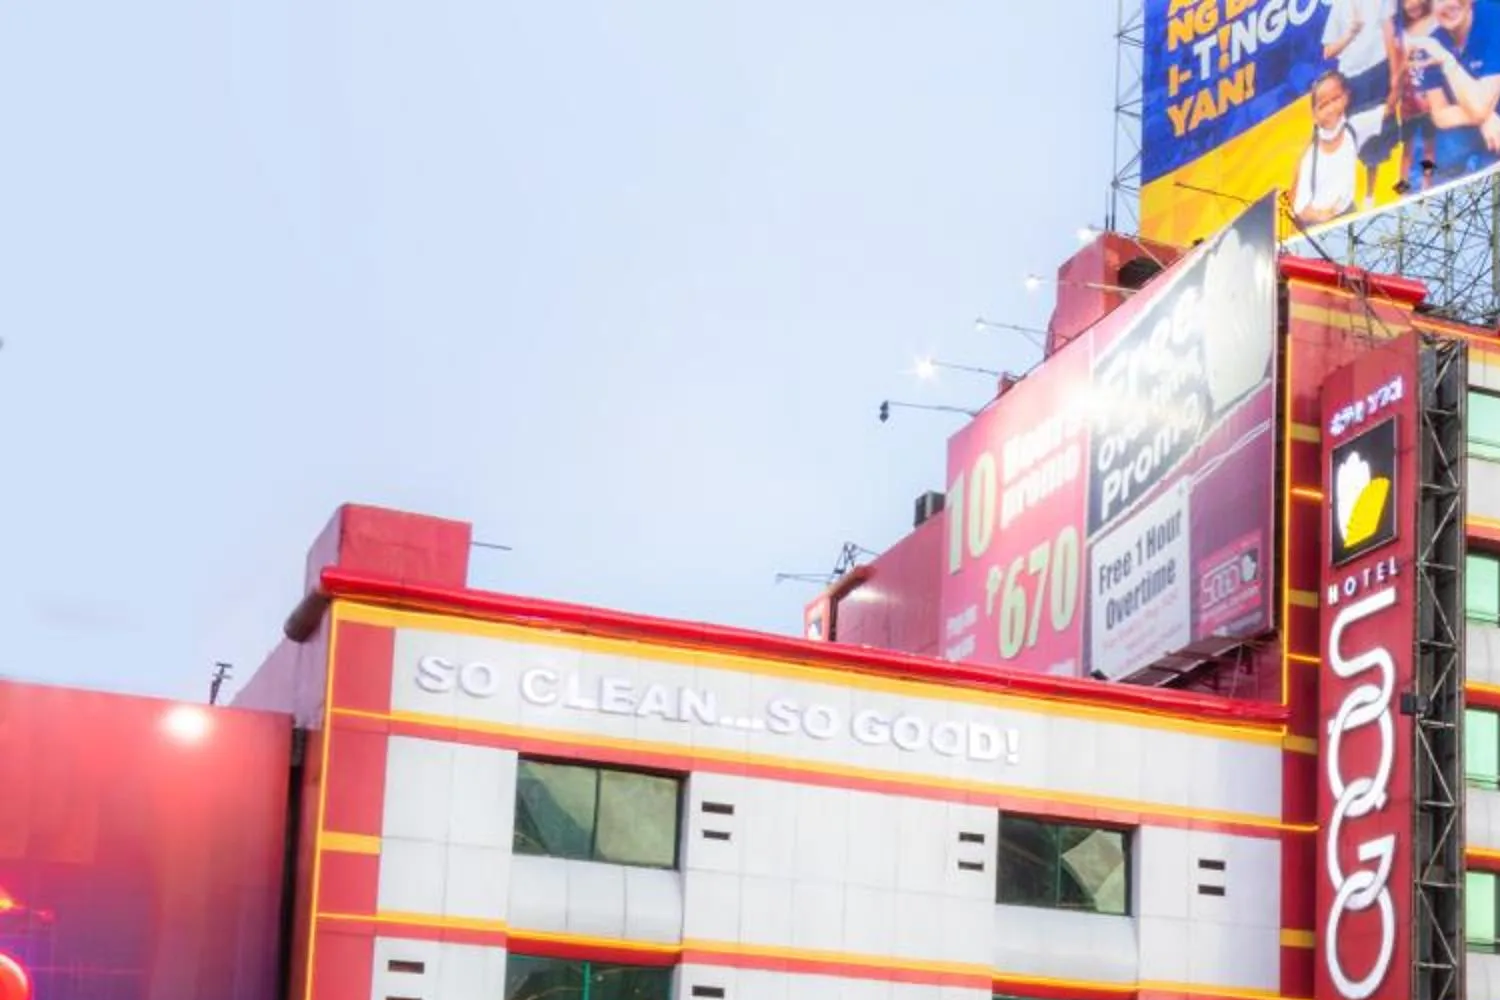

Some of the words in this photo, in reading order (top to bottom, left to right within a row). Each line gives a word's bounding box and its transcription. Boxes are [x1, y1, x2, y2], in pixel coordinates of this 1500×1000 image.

[1167, 3, 1220, 52] NG
[1166, 61, 1256, 138] YAN!
[947, 452, 997, 576] 10
[1099, 551, 1133, 596] Free
[1135, 537, 1144, 567] 1
[1145, 509, 1183, 560] Hour
[1105, 558, 1177, 631] Overtime
[1327, 556, 1399, 605] HOTEL
[415, 655, 500, 699] SO
[850, 708, 1022, 766] GOOD!
[1326, 586, 1397, 1000] SOGO
